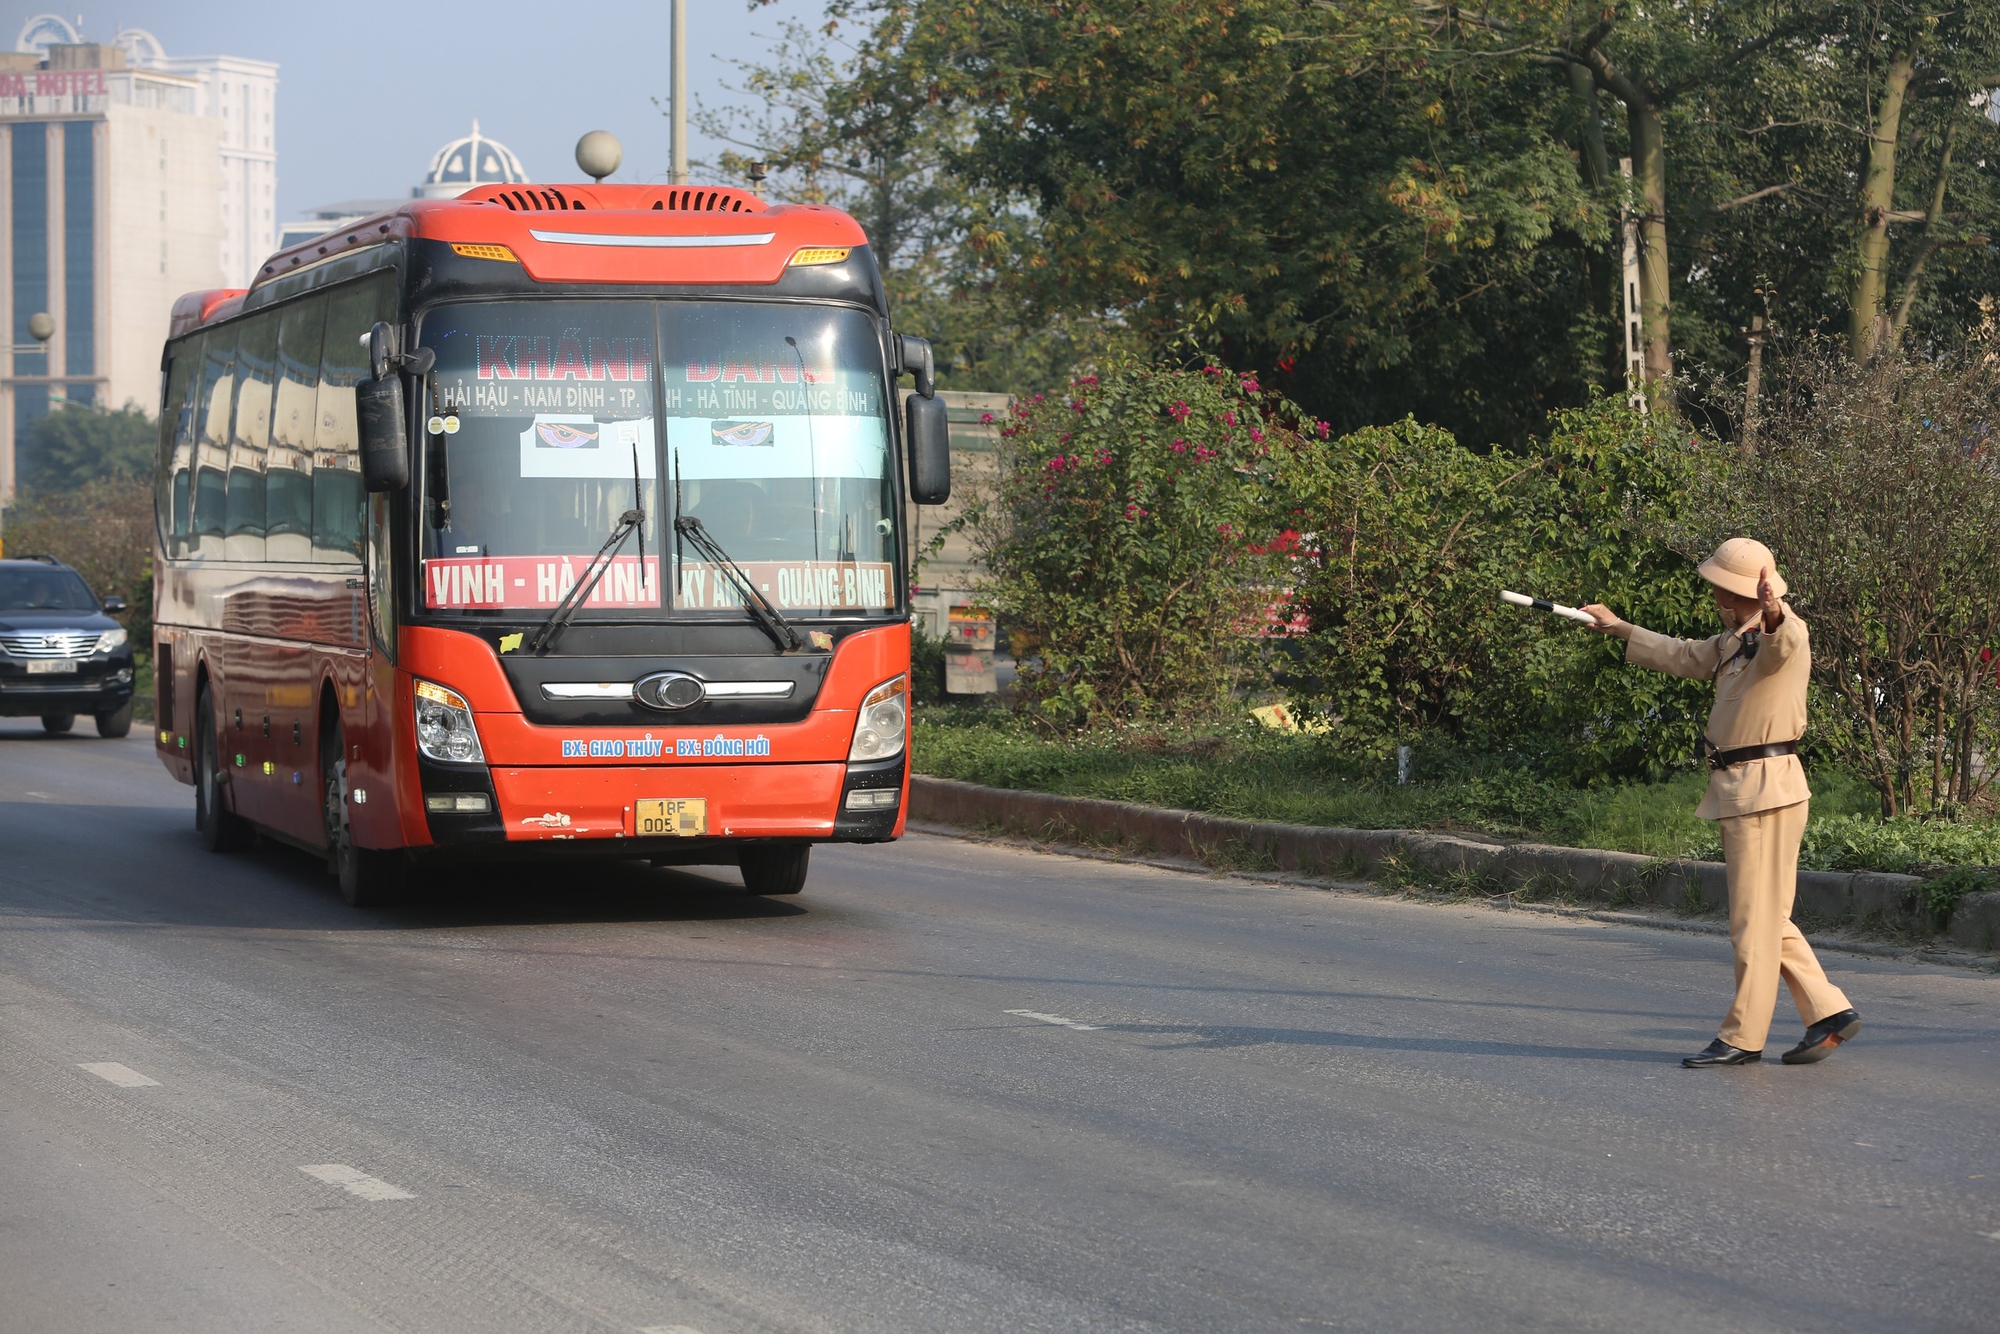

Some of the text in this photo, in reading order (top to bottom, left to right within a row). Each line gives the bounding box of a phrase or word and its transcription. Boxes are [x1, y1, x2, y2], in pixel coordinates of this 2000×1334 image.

[36, 70, 109, 97] HOTEL
[476, 327, 666, 382] KHÁNH
[444, 378, 471, 408] HẢI
[475, 381, 508, 411] HẬU
[524, 386, 562, 407] NAM
[566, 382, 605, 412] ĐỊNH
[619, 387, 640, 408] TP.
[698, 382, 720, 409] HÀ
[723, 384, 757, 410] TĨNH
[772, 382, 832, 411] QUẢNG
[836, 384, 868, 413] BÌNH
[431, 564, 505, 605] VINH
[537, 556, 580, 603] HÀ
[586, 556, 656, 603] TĨNH
[682, 562, 706, 608] KỲ
[777, 561, 840, 608] QUẢNG
[844, 561, 887, 608] BÌNH
[562, 739, 587, 757] BX:
[590, 739, 624, 757] GIAO
[626, 733, 663, 757] THỦY
[676, 738, 701, 757] BX:
